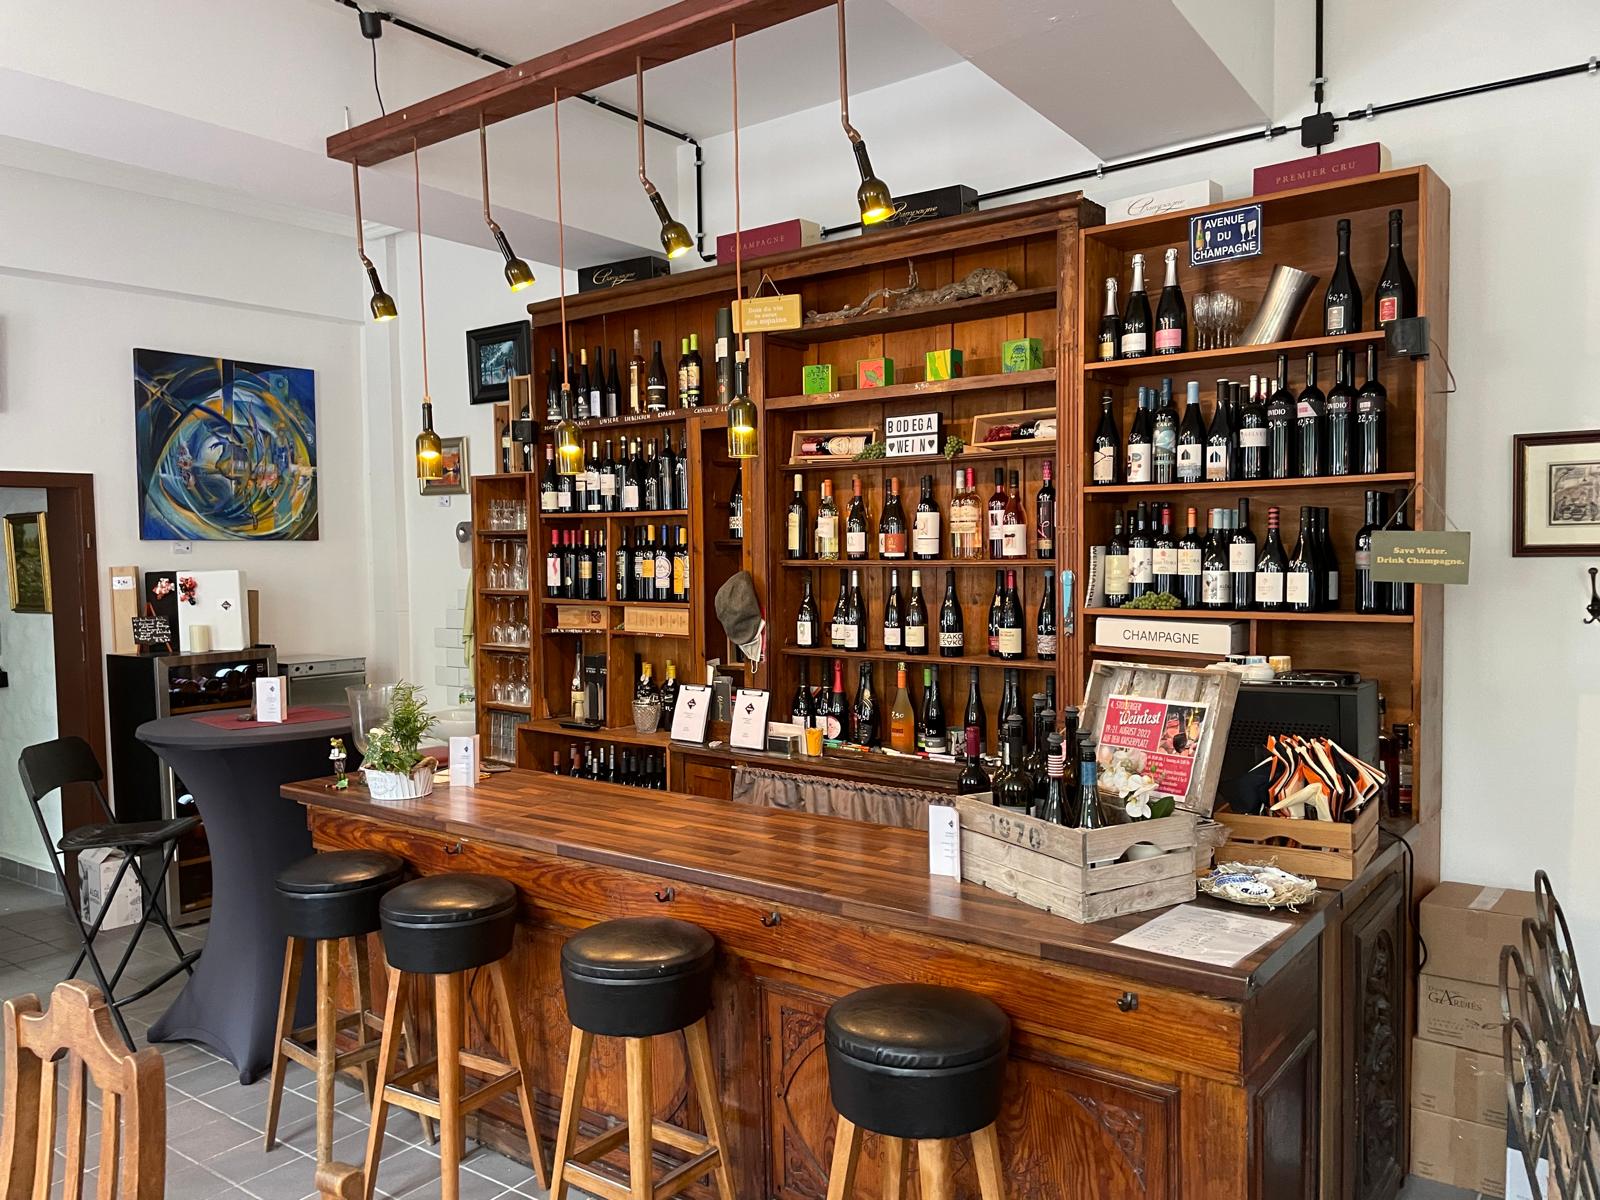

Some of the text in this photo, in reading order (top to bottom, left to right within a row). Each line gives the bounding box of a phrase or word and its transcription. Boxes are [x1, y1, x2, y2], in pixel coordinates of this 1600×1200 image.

[1275, 160, 1357, 185] PREMIER CRU
[1203, 213, 1246, 230] AVENUE
[729, 234, 786, 254] CAMPAGNE
[1216, 230, 1232, 242] DU
[1193, 240, 1258, 261] CHAMPAGNE
[887, 418, 933, 434] BODEGA
[896, 438, 926, 455] WEIN
[1393, 546, 1448, 556] Save Water.
[1376, 556, 1466, 568] Drink Champagne.
[1122, 628, 1200, 646] CHAMPAGNE
[1119, 709, 1162, 725] Weinfest
[1118, 725, 1138, 736] AUGUST
[1137, 728, 1151, 738] 2022
[1102, 734, 1111, 743] AUF
[1120, 736, 1149, 748] KAISERPLATZ
